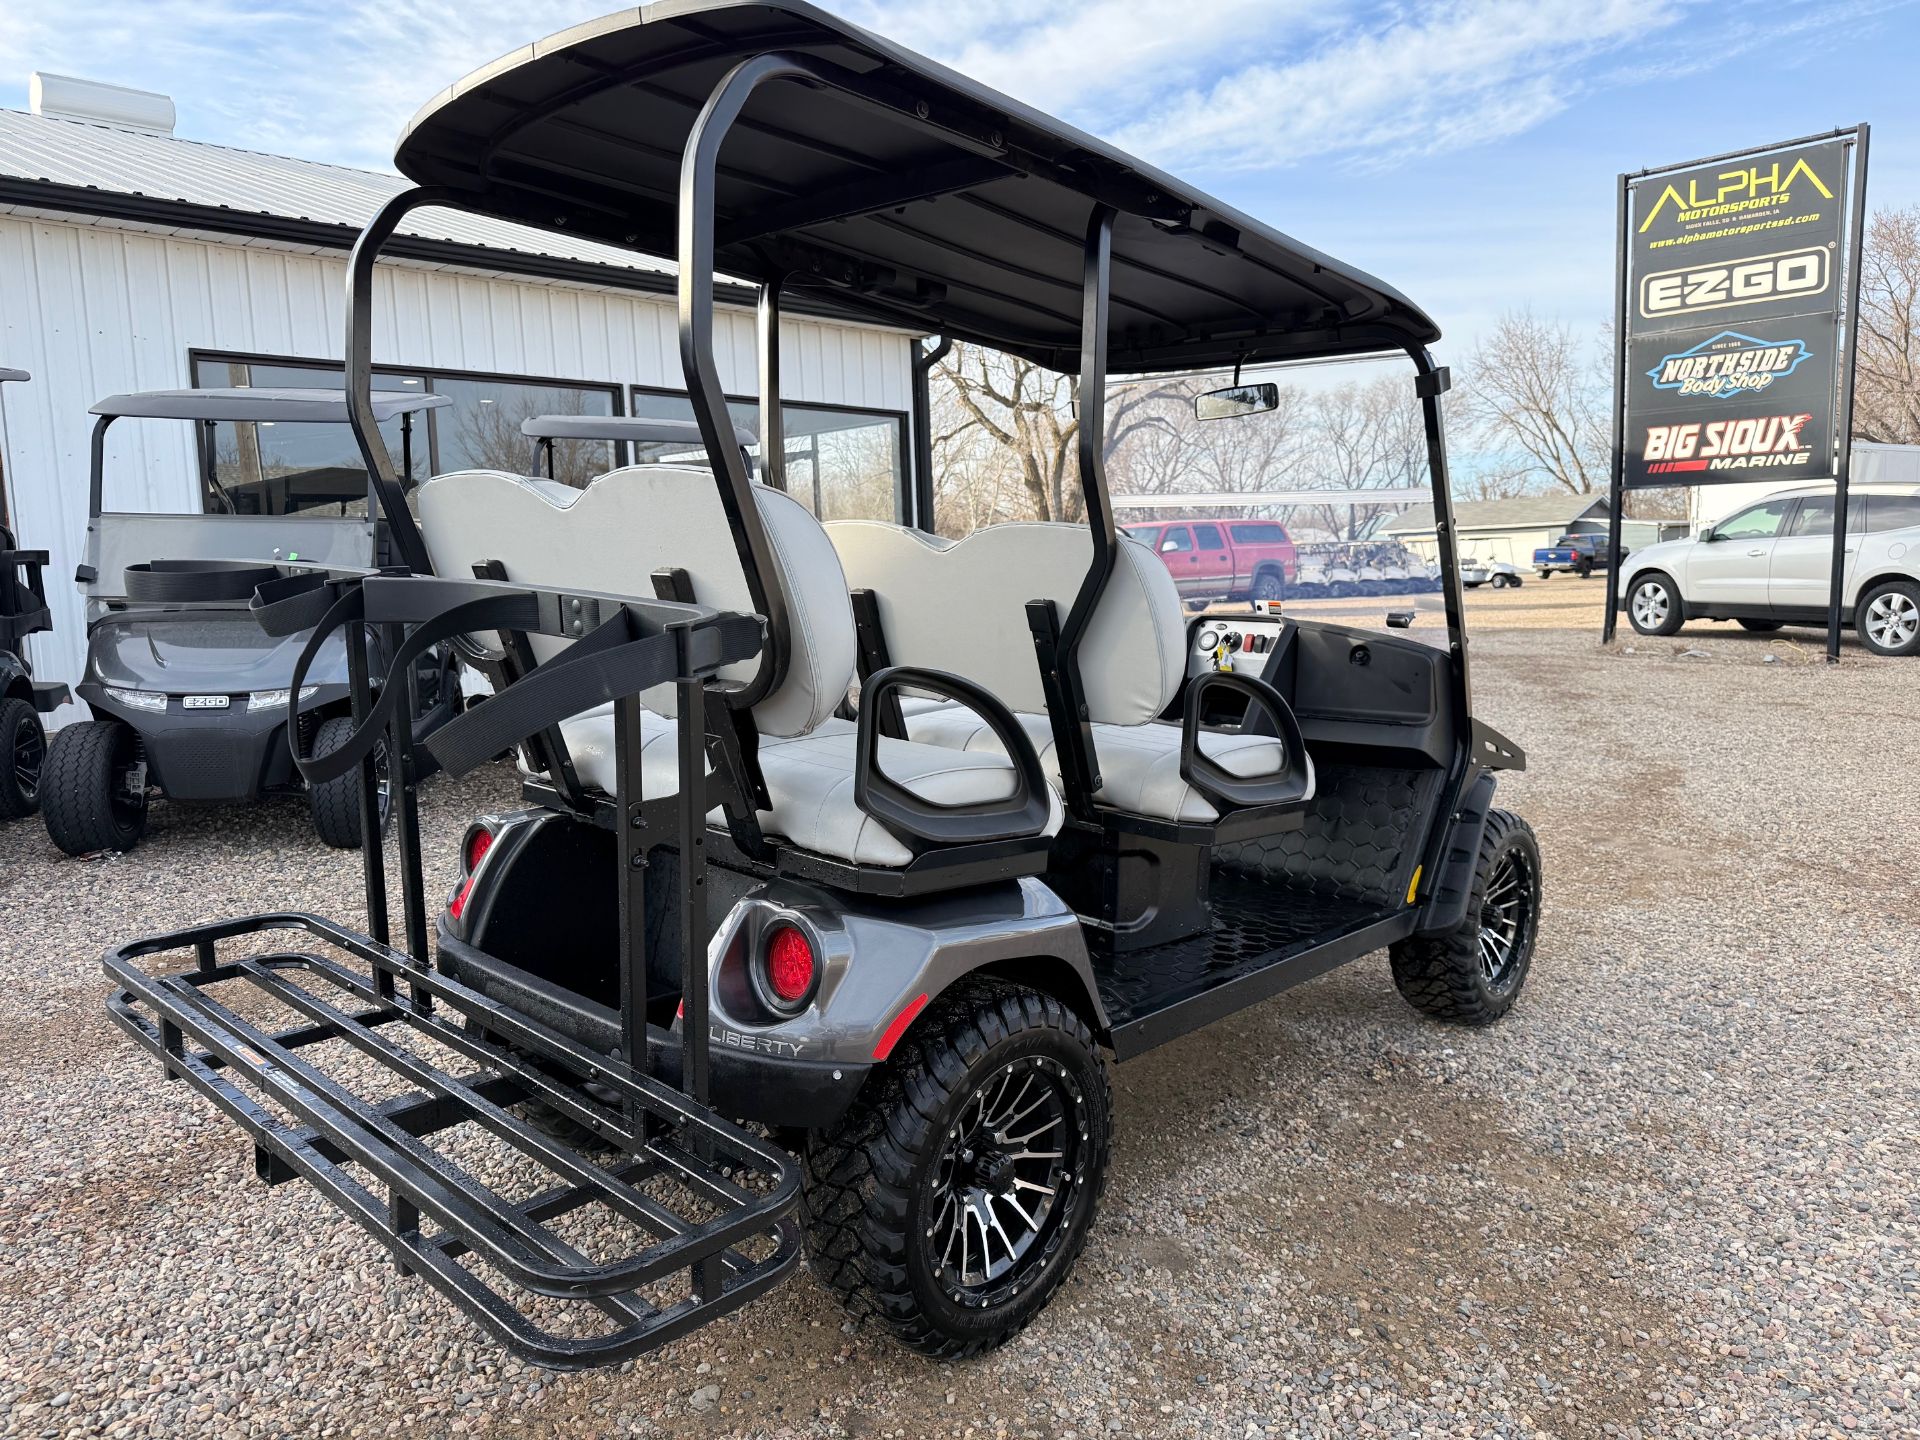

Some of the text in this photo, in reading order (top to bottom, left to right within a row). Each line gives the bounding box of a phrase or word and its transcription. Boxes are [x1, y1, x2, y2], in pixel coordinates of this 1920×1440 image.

[1639, 158, 1834, 233] ALPHA
[1677, 193, 1791, 222] MOTORSPORTS
[1649, 213, 1821, 249] www.alphamotorsportssd.com
[1660, 346, 1795, 383] NORTHSIDE
[1679, 371, 1774, 396] Body Shop
[1643, 413, 1812, 461] BIG SIOUX
[1709, 452, 1811, 470] MARINE
[709, 1026, 804, 1057] LIBERTY
